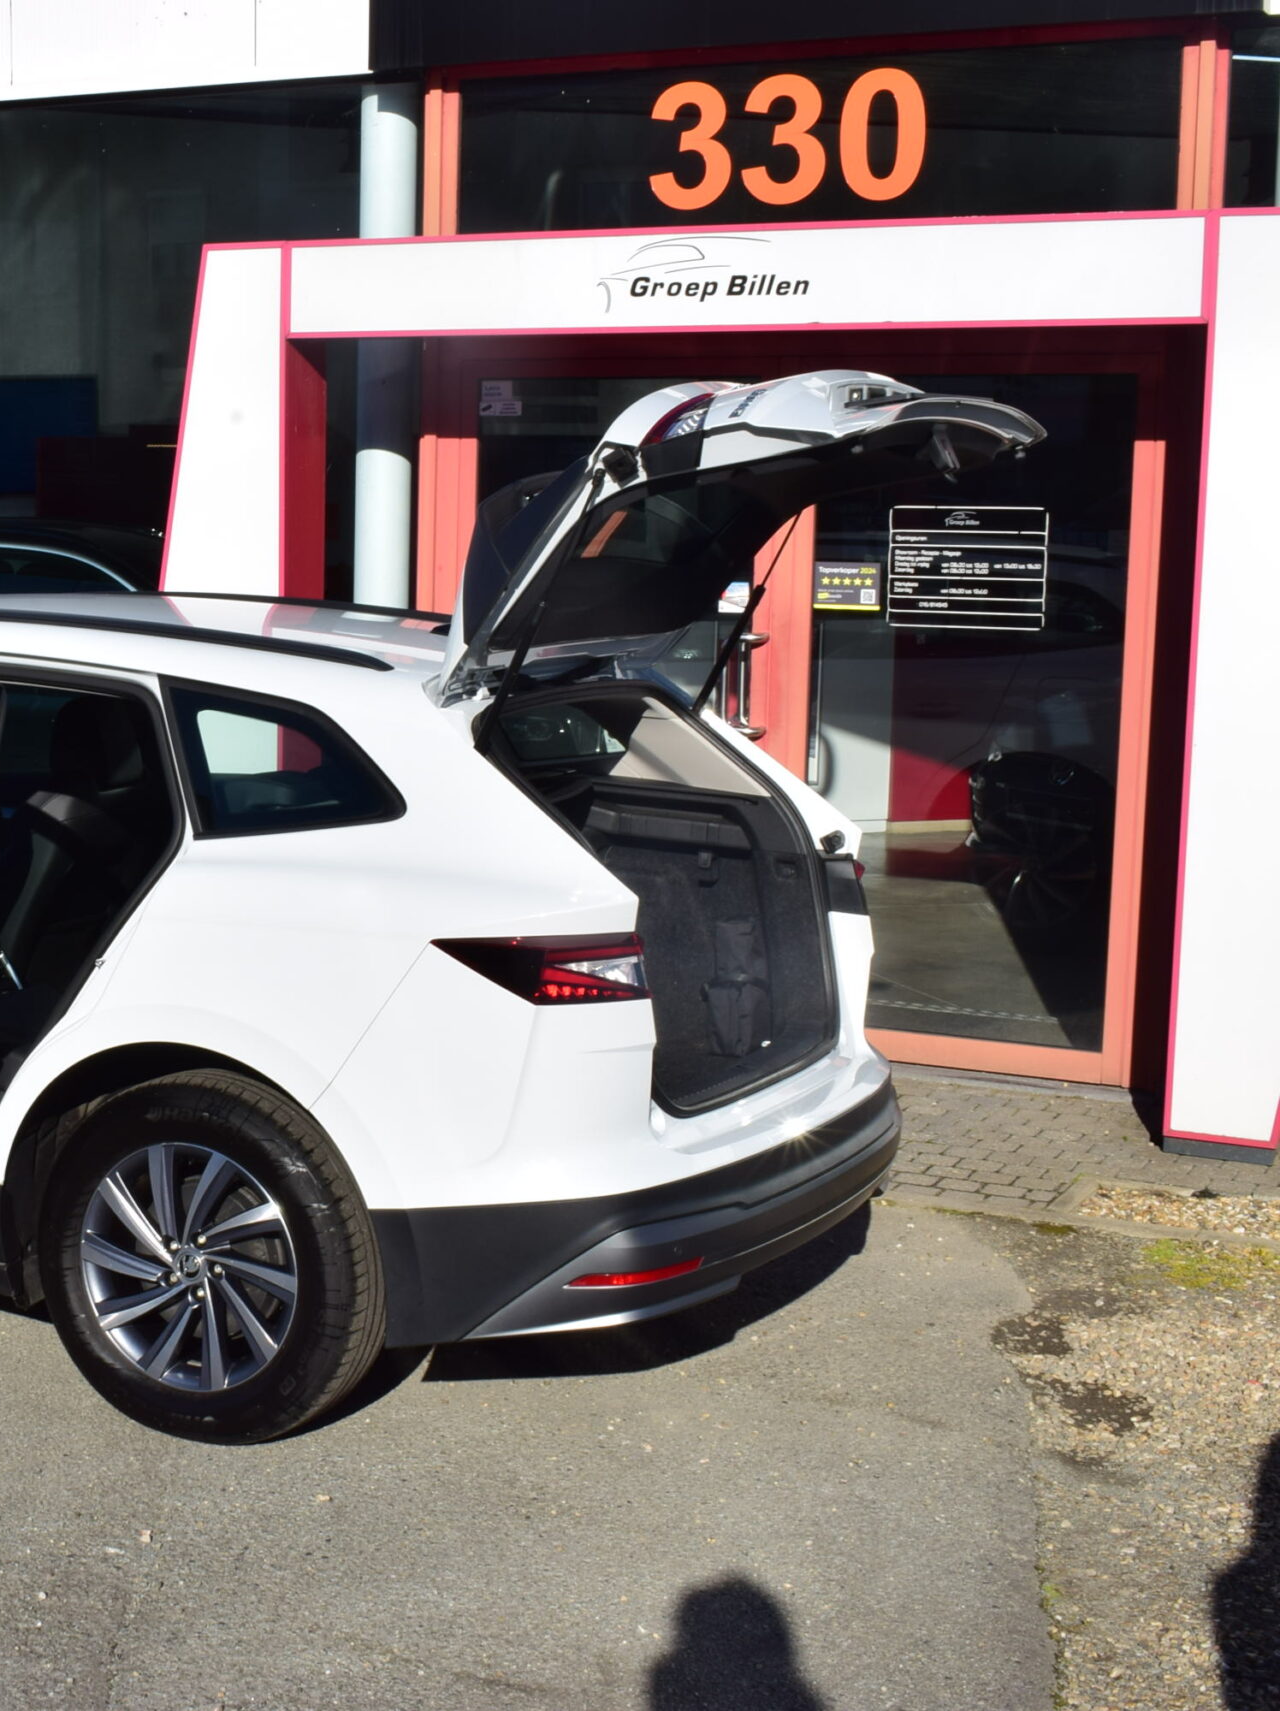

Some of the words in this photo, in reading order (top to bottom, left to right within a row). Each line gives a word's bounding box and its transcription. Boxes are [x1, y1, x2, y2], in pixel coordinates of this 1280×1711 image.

[648, 67, 927, 210] 330
[630, 276, 718, 302] Groep
[726, 274, 810, 296] Billen
